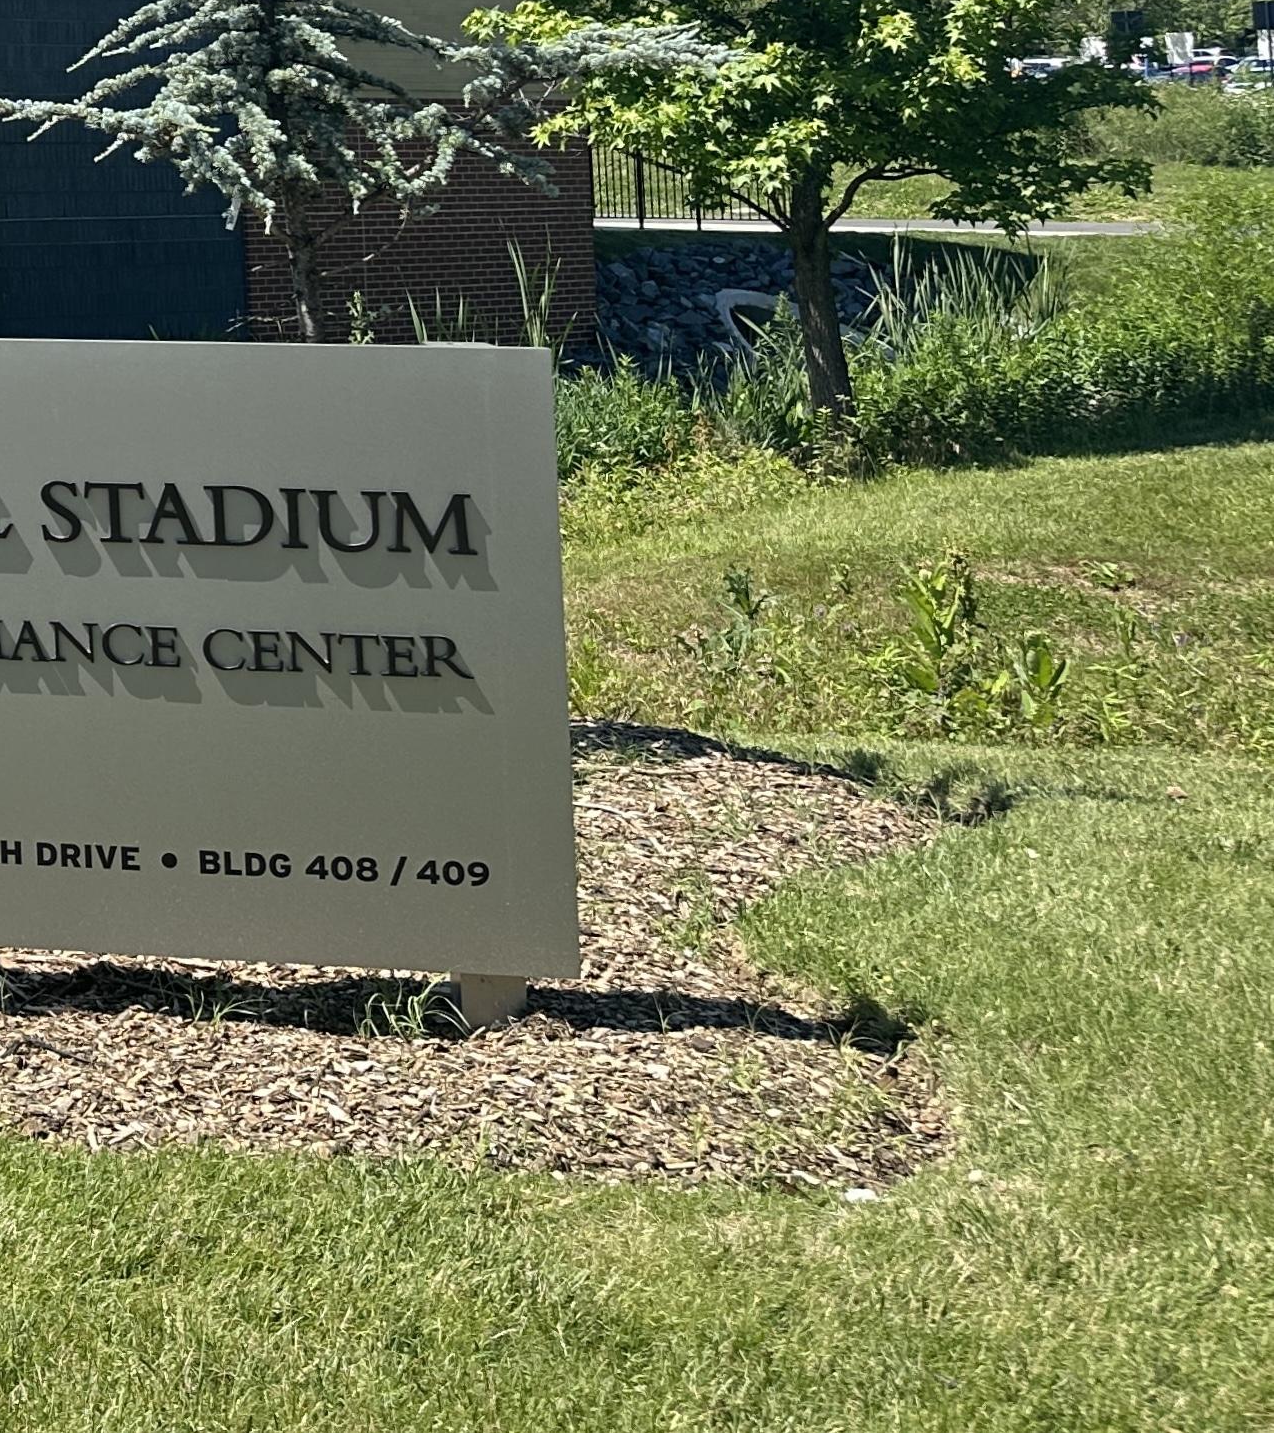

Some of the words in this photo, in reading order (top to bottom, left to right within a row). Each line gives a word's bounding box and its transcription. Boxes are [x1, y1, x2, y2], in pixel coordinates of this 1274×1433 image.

[40, 480, 479, 556] STADIUM
[202, 628, 476, 681] CENTER
[36, 841, 141, 872] DRIVE
[198, 849, 292, 879] BLDG
